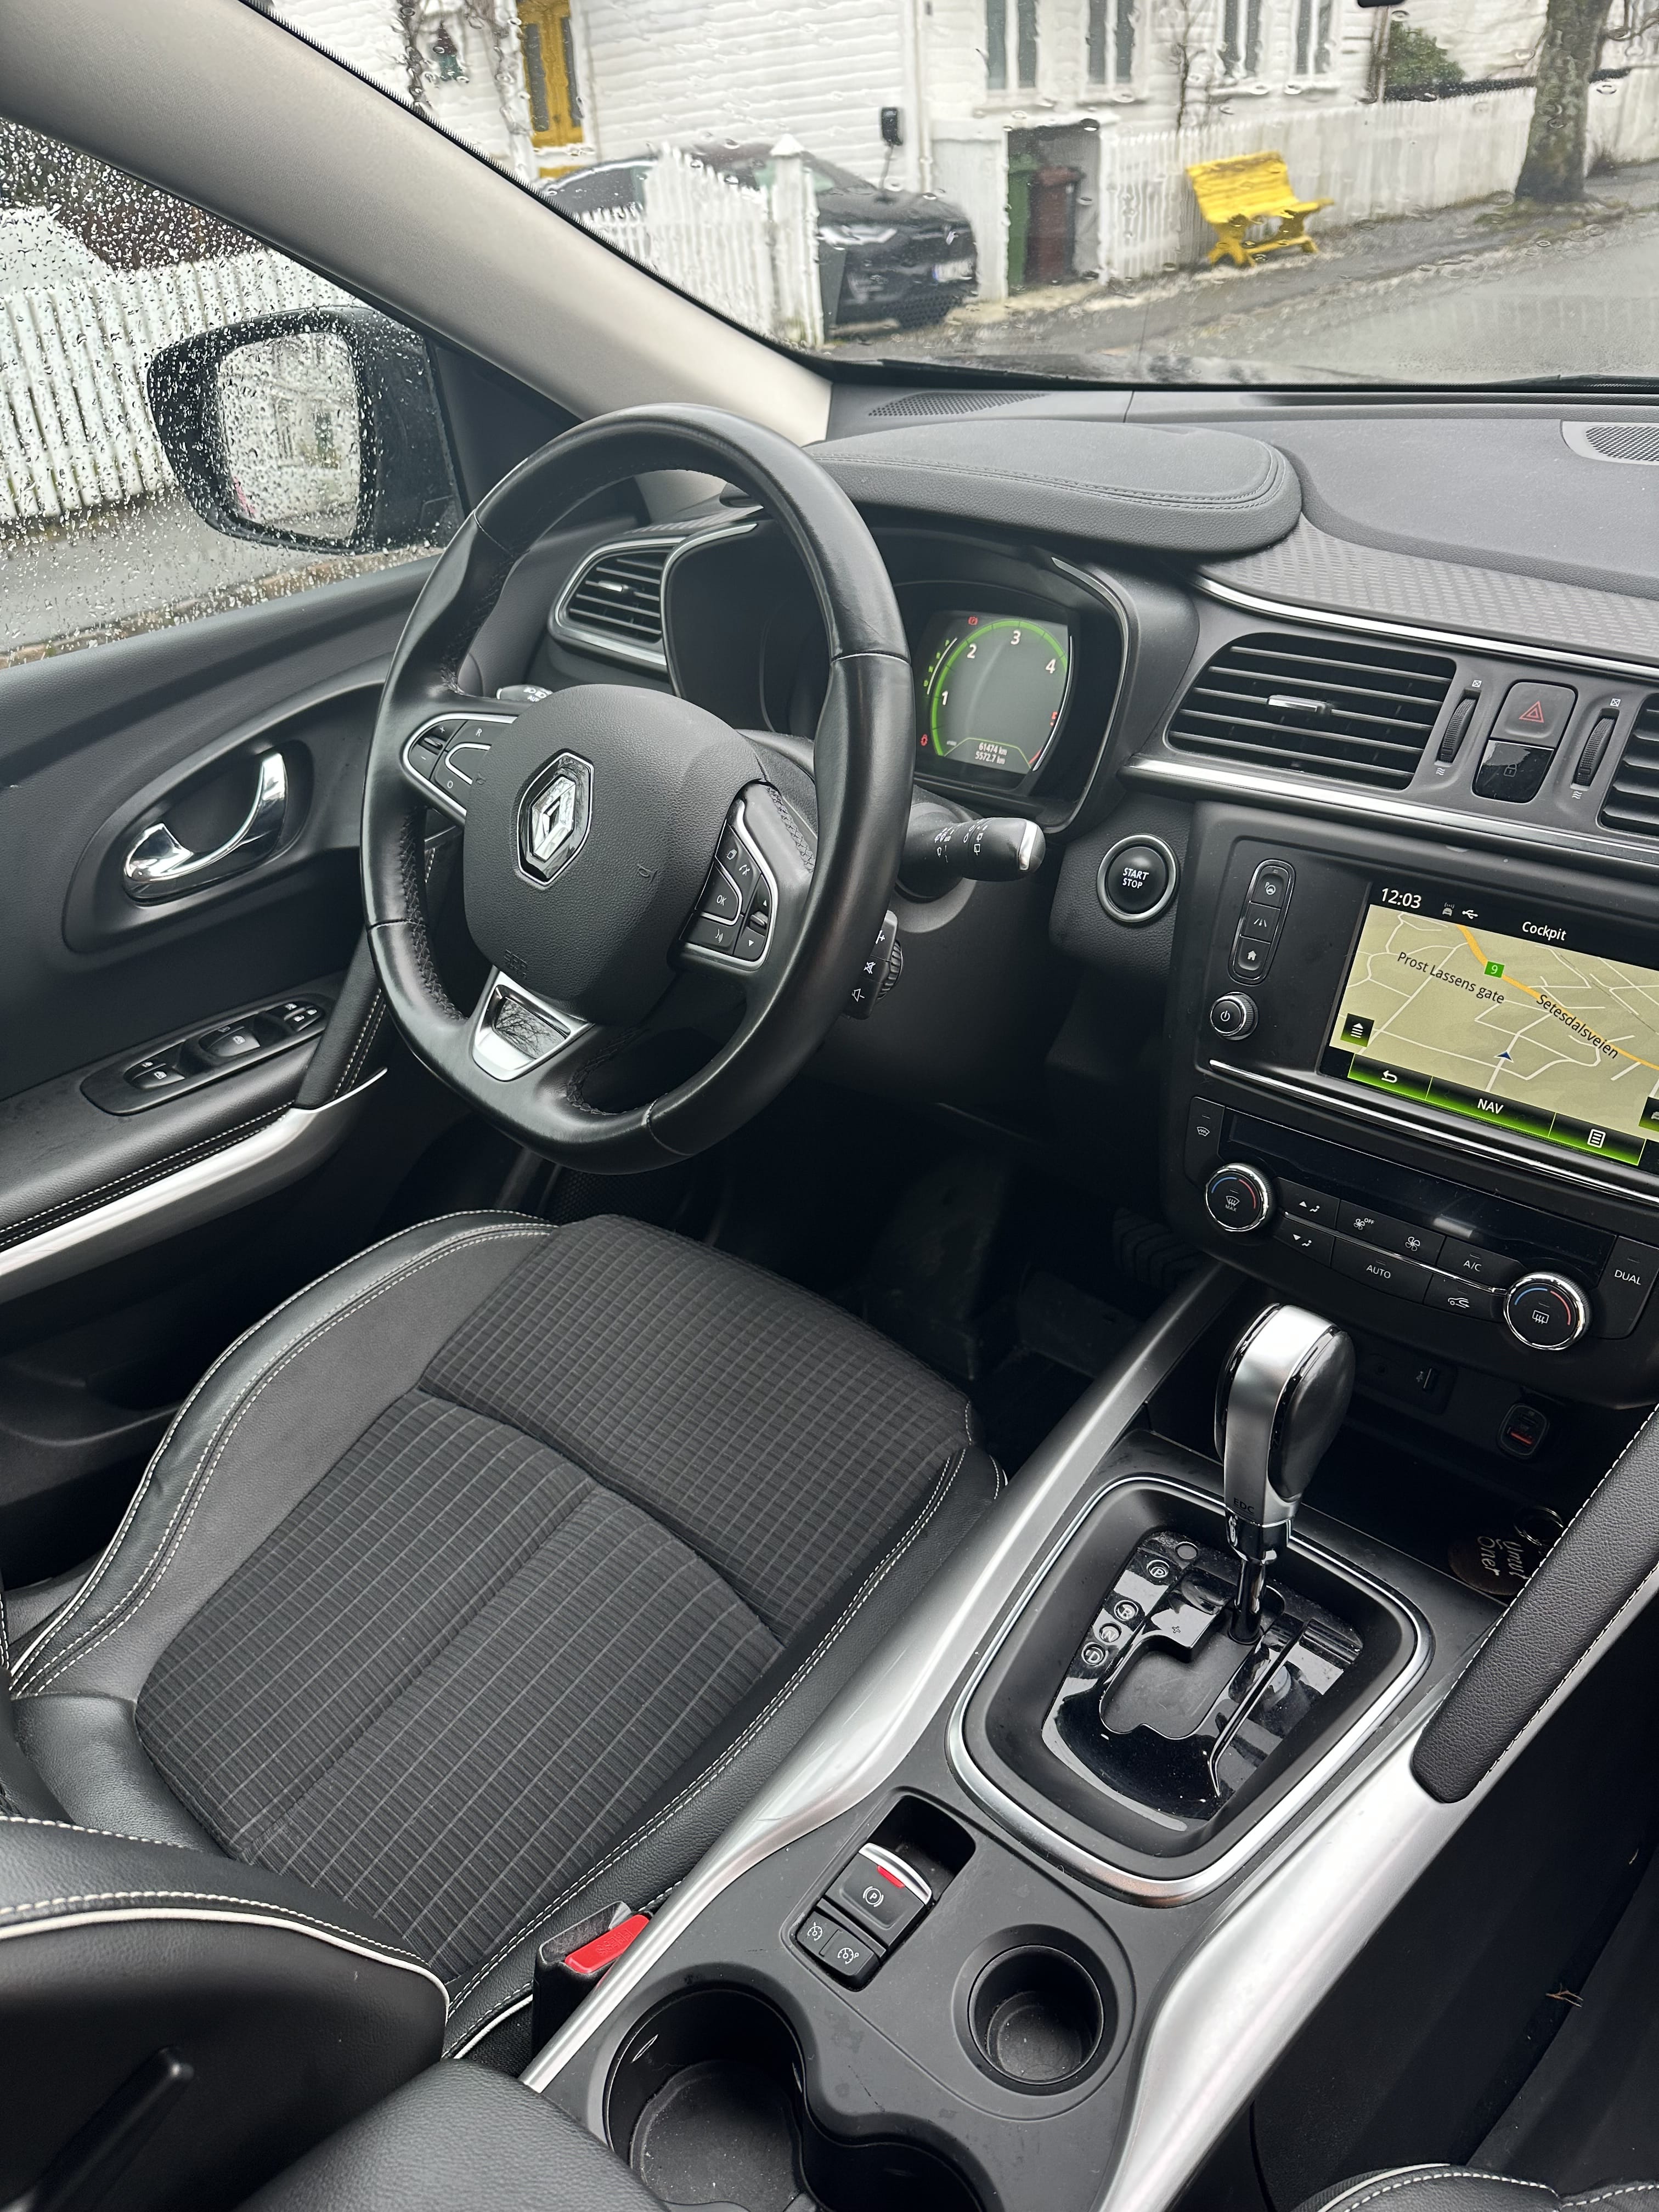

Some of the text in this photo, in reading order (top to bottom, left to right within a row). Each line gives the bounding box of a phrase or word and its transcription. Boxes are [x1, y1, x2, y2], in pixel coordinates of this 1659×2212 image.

[1011, 630, 1021, 645] 3
[967, 644, 977, 659] 2
[1045, 659, 1056, 674] 4
[941, 691, 949, 706] 1
[475, 728, 483, 737] R
[978, 742, 1007, 755] 61474 km
[975, 751, 1006, 765] 5572.7 km
[1122, 867, 1149, 881] START
[1122, 878, 1143, 889] STOP
[716, 895, 727, 906] OK
[1381, 888, 1422, 909] 12:03
[1521, 921, 1567, 941] Cockpit
[1491, 964, 1499, 974] 9
[1397, 952, 1504, 1004] Prost Lassens gate
[1536, 993, 1619, 1060] Setesdalsveien
[1477, 1098, 1504, 1115] NAV
[1366, 1265, 1391, 1280] AUTO
[1463, 1259, 1482, 1273] A/C
[1614, 1269, 1641, 1286] DUAL
